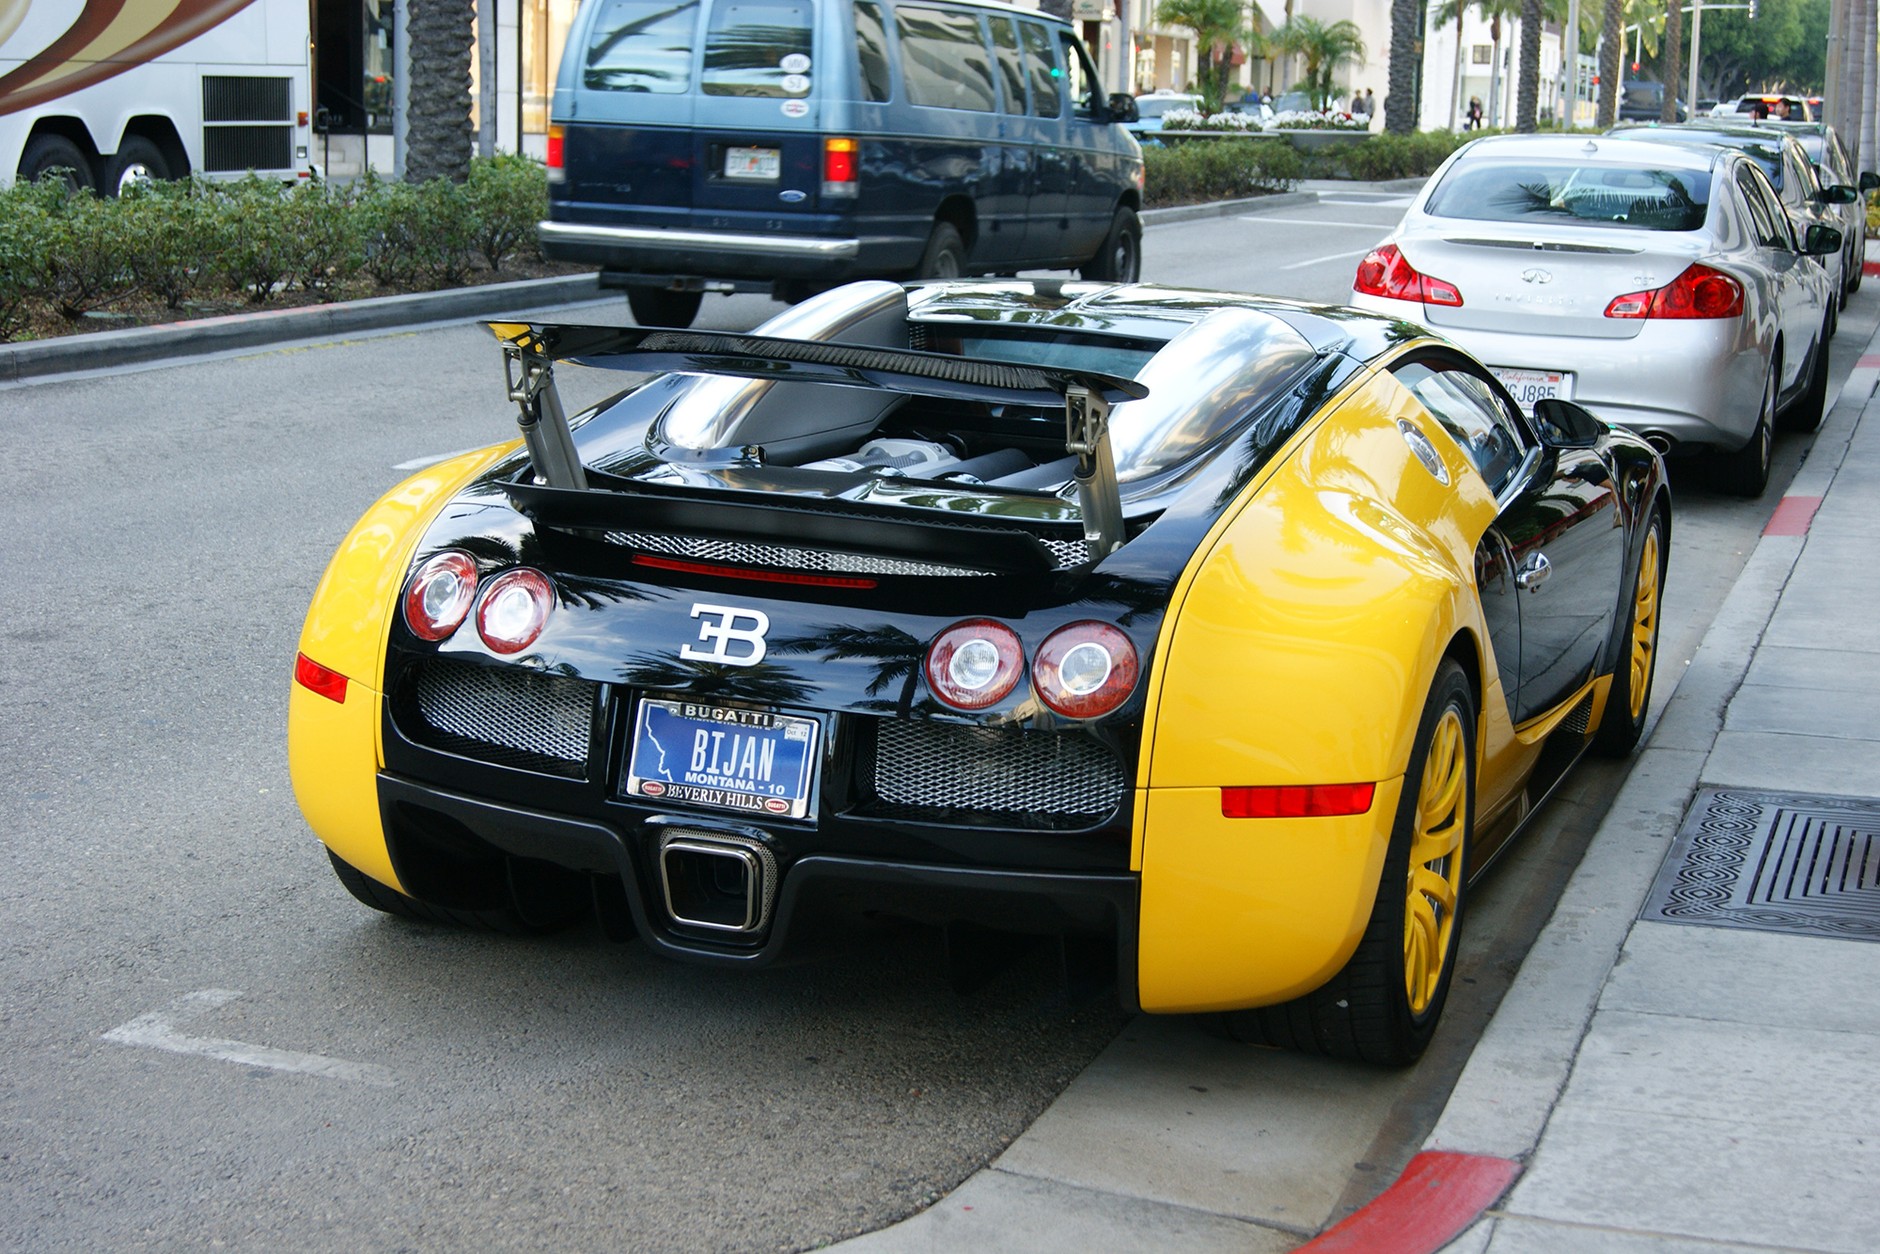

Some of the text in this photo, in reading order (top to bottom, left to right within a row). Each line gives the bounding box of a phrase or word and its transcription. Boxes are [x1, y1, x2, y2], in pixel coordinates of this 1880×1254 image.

[1505, 383, 1556, 403] GJ885
[685, 705, 769, 726] BUGATTI
[690, 728, 776, 782] BIJAN
[684, 771, 755, 791] MONTANA
[768, 784, 785, 795] 10
[666, 783, 763, 810] BEVERLY HILLS
